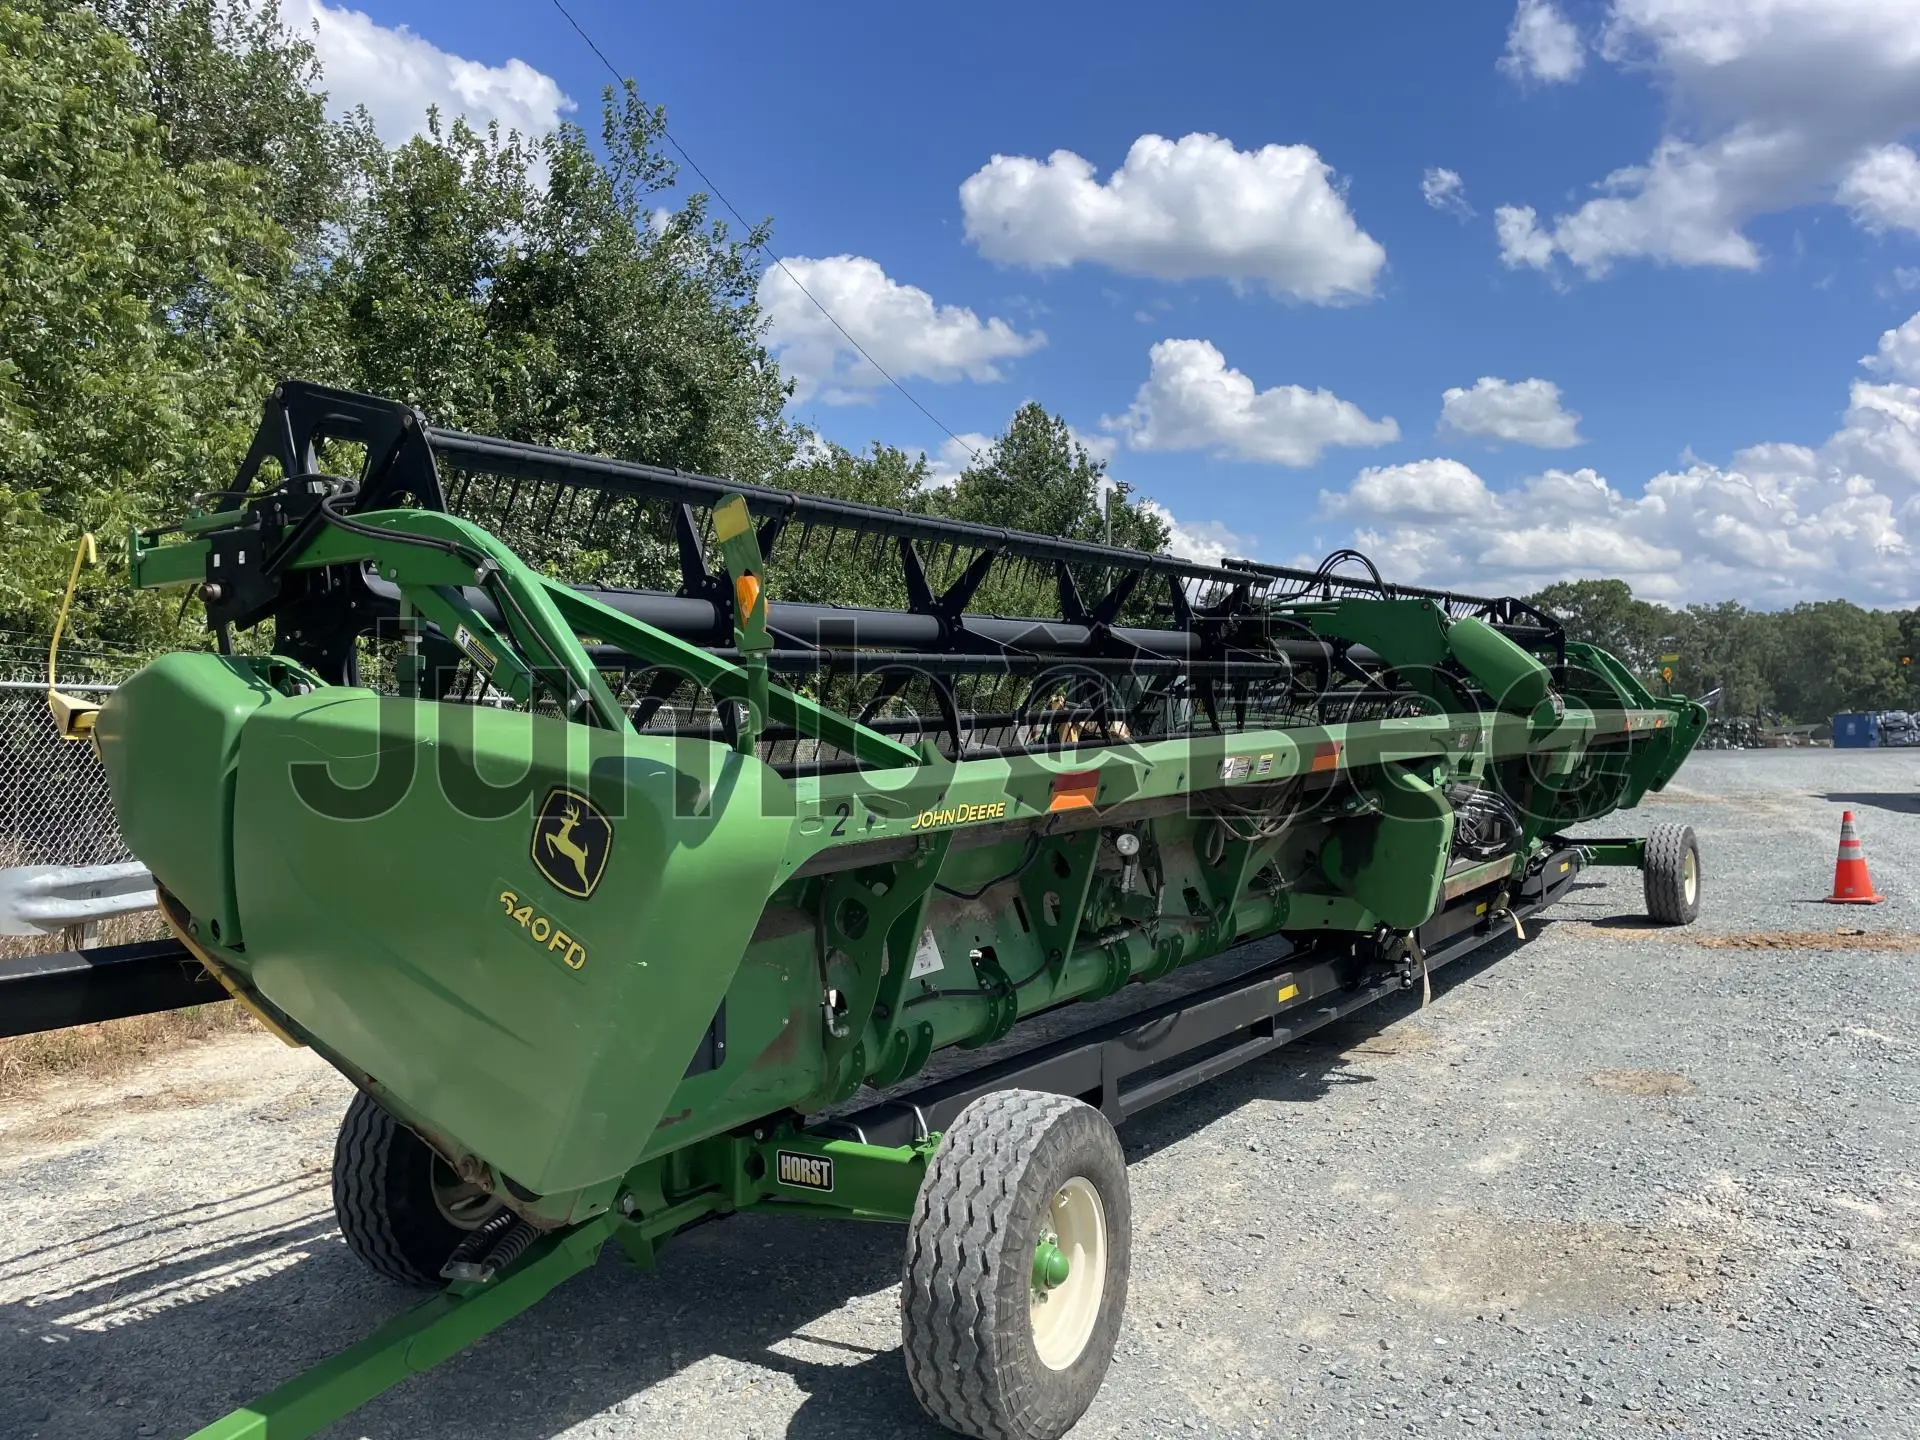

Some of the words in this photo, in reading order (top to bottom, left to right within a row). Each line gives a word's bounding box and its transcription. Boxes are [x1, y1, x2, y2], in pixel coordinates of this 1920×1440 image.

[830, 802, 850, 837] 2
[910, 808, 956, 829] JOHN
[956, 802, 1006, 823] DEERE
[781, 1155, 830, 1187] HORST
